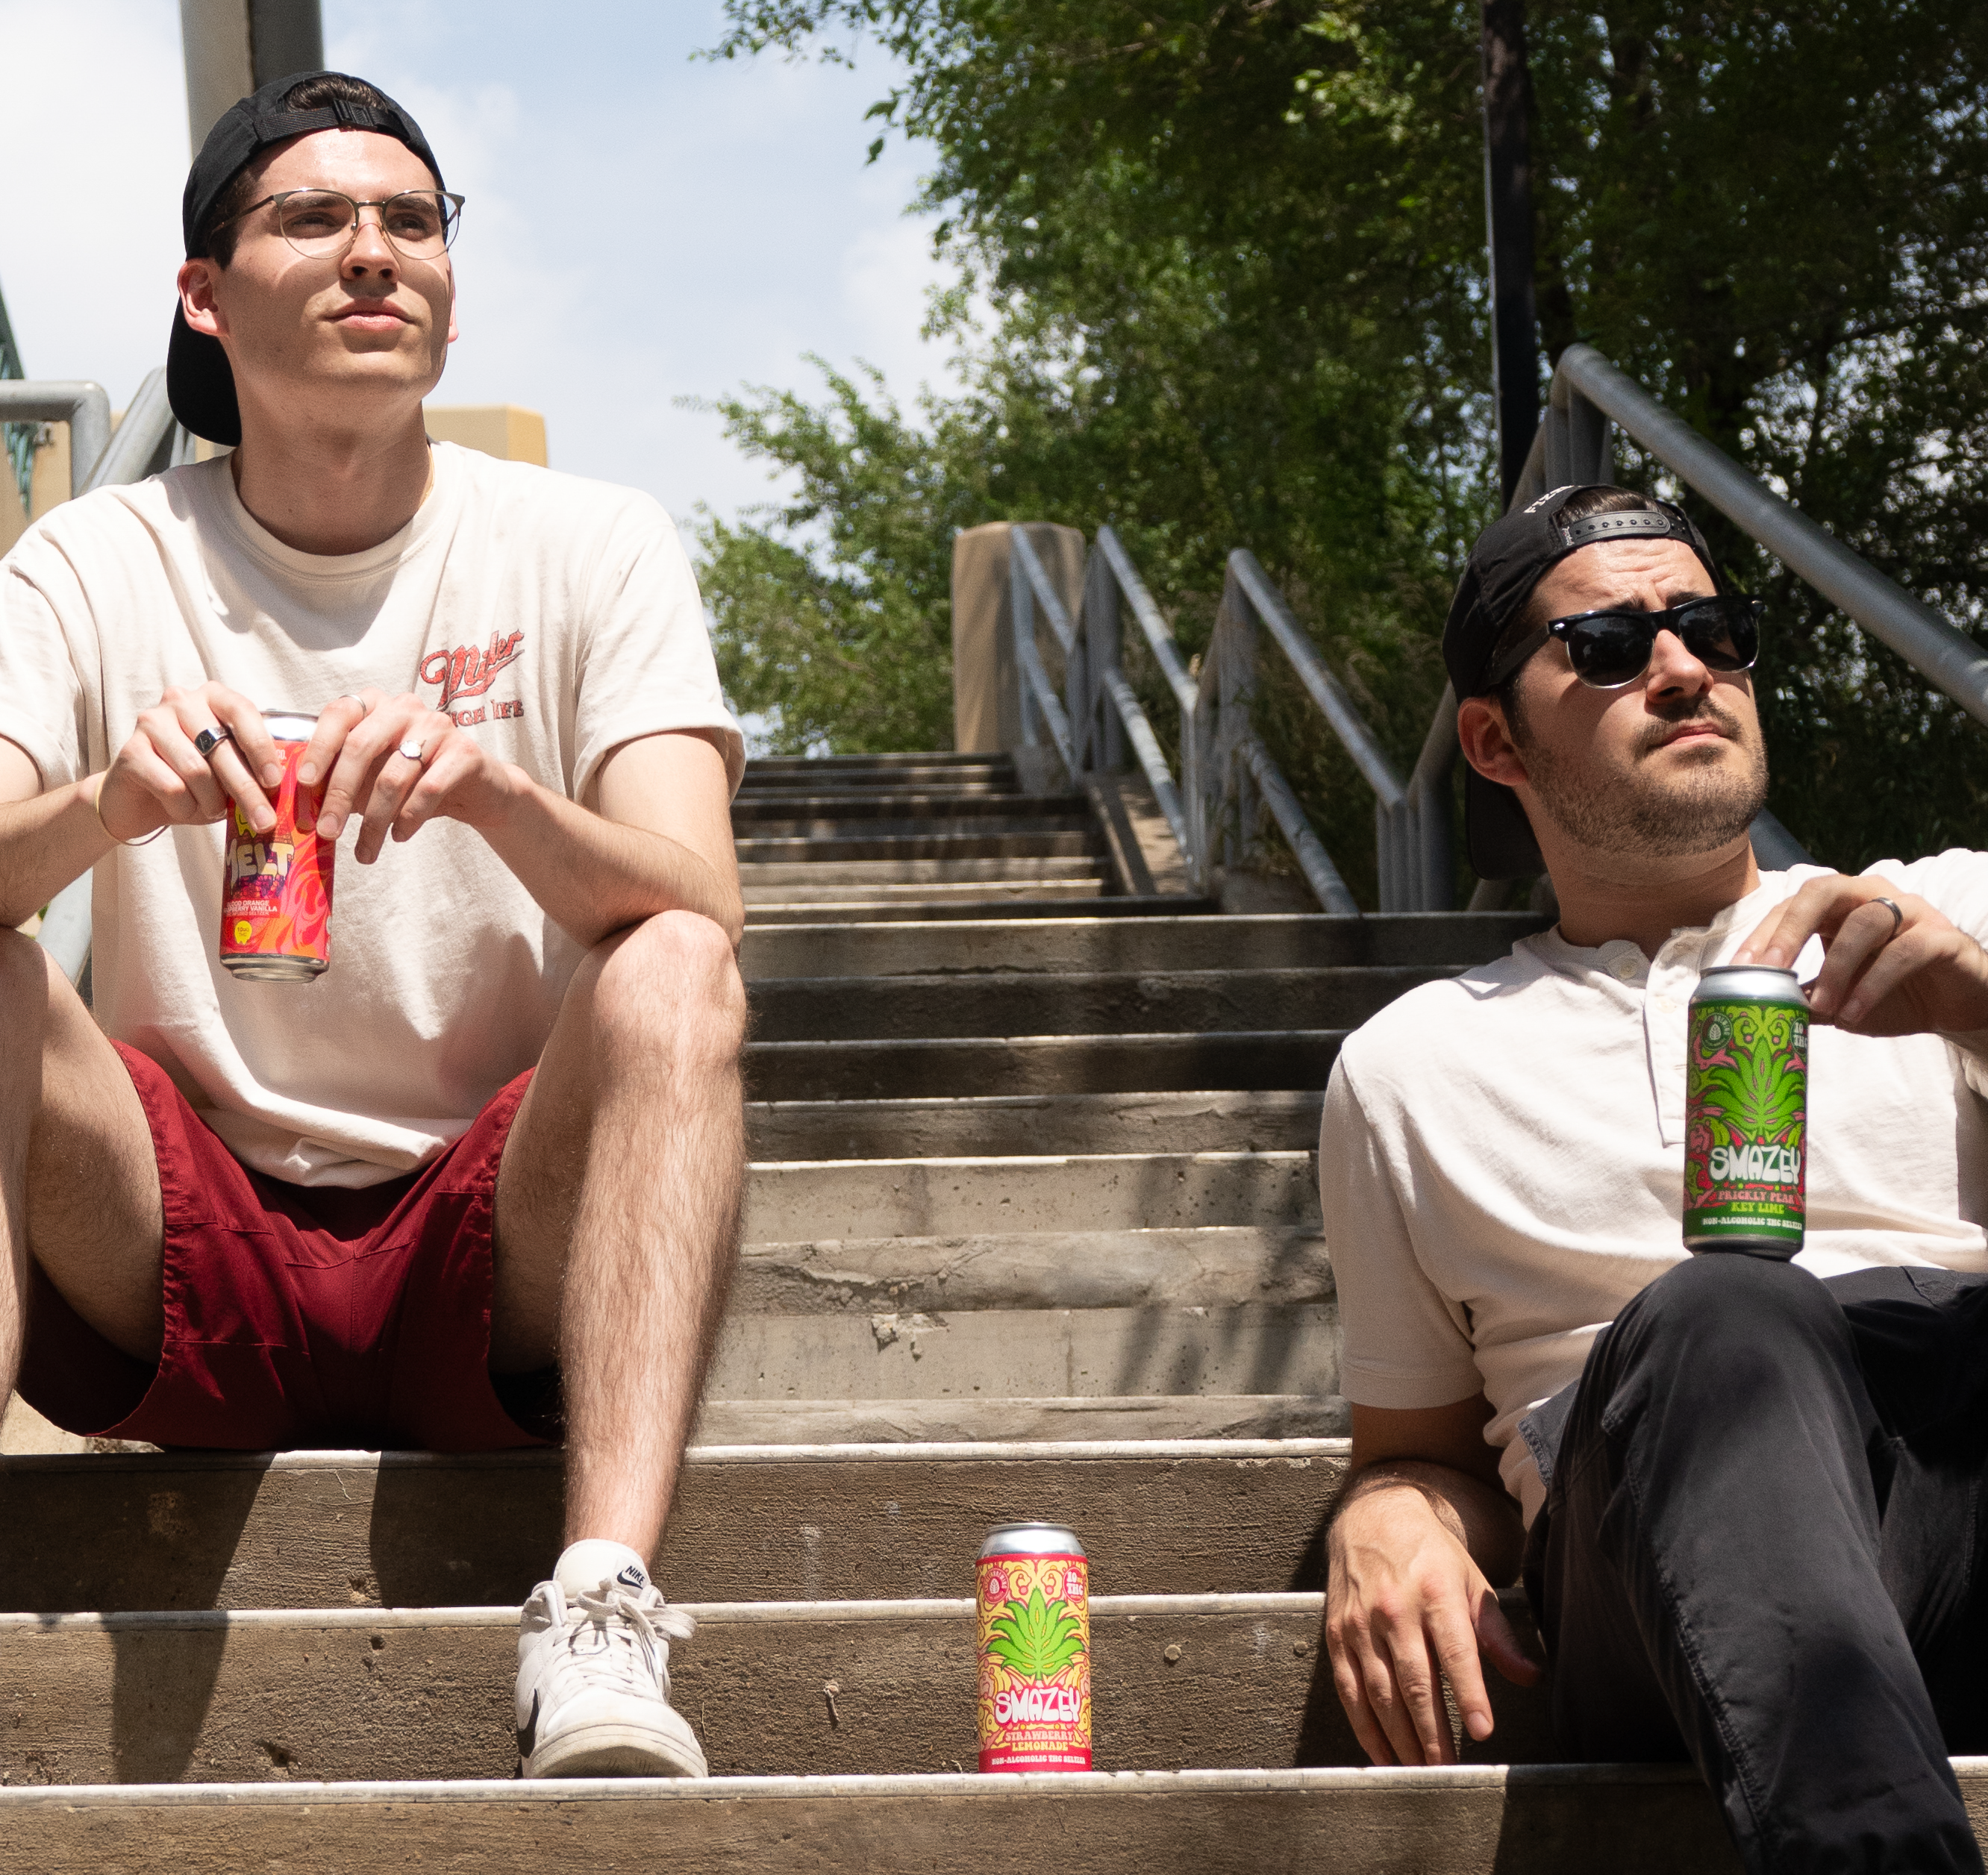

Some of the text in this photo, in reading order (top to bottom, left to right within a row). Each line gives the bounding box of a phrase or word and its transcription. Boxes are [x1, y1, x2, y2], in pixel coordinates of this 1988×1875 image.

[420, 629, 525, 712] Miler
[449, 706, 487, 728] IGH
[1710, 1145, 1801, 1185] SMAZEY
[1717, 1190, 1795, 1204] PRICKLY PEAR
[1731, 1201, 1784, 1215] KEY LIME
[1702, 1216, 1766, 1226] NON-ALCOHOLIC
[625, 1565, 645, 1585] NIKE
[1066, 1571, 1077, 1583] 10
[1066, 1583, 1084, 1596] THC
[995, 1687, 1081, 1724] SMAZEY
[1004, 1730, 1073, 1741] STRAWBERRY
[1011, 1741, 1069, 1751] LEMONADE
[992, 1755, 1048, 1765] NON-ALCOHOLIC
